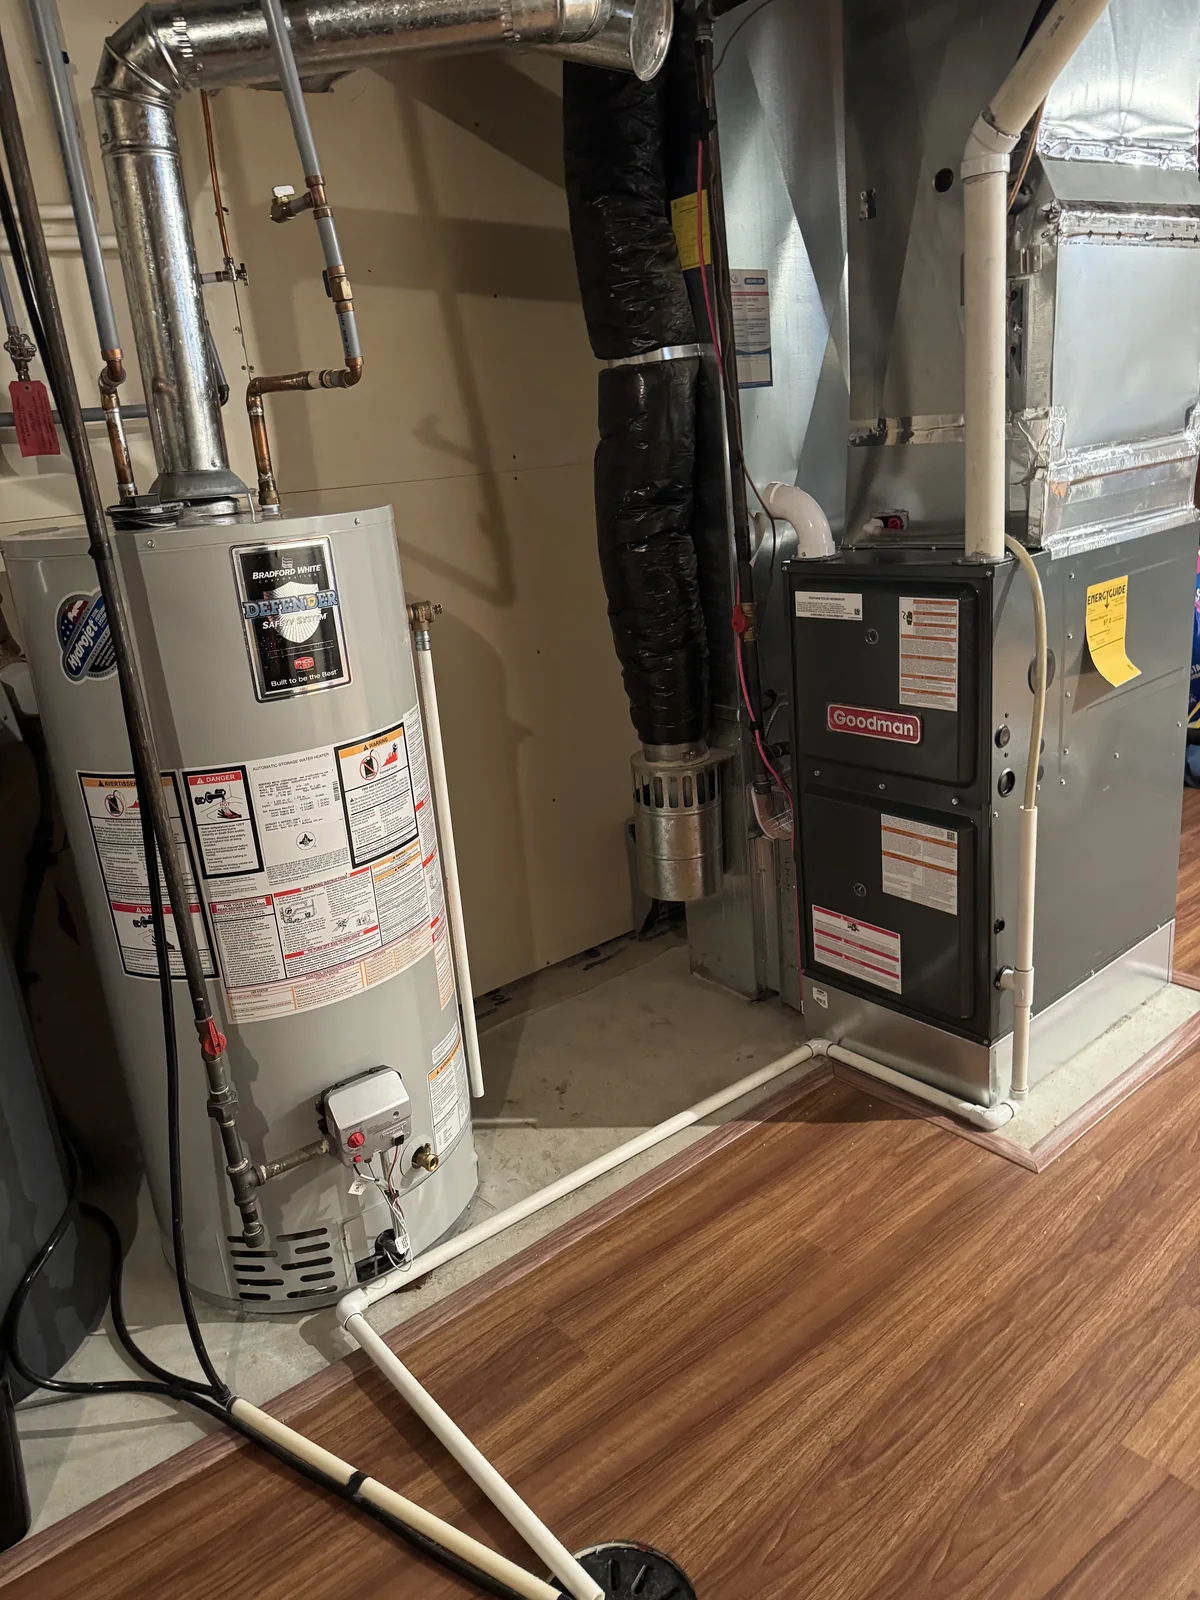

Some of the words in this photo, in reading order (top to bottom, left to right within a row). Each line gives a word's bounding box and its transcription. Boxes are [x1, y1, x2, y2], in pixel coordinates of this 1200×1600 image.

[252, 568, 296, 580] BRADFORD
[297, 564, 322, 574] WHITE
[1087, 584, 1126, 605] ENERGYGUIDE
[243, 590, 339, 619] DEFENDER
[67, 619, 99, 671] Hydrojet
[271, 678, 287, 687] Built
[289, 676, 297, 684] to
[298, 674, 308, 682] be
[309, 672, 320, 681] the
[321, 669, 338, 679] Best
[833, 710, 914, 737] Goodman
[369, 737, 389, 748] WARNING
[253, 763, 278, 771] AUTOMATIC
[206, 774, 236, 783] DANGER
